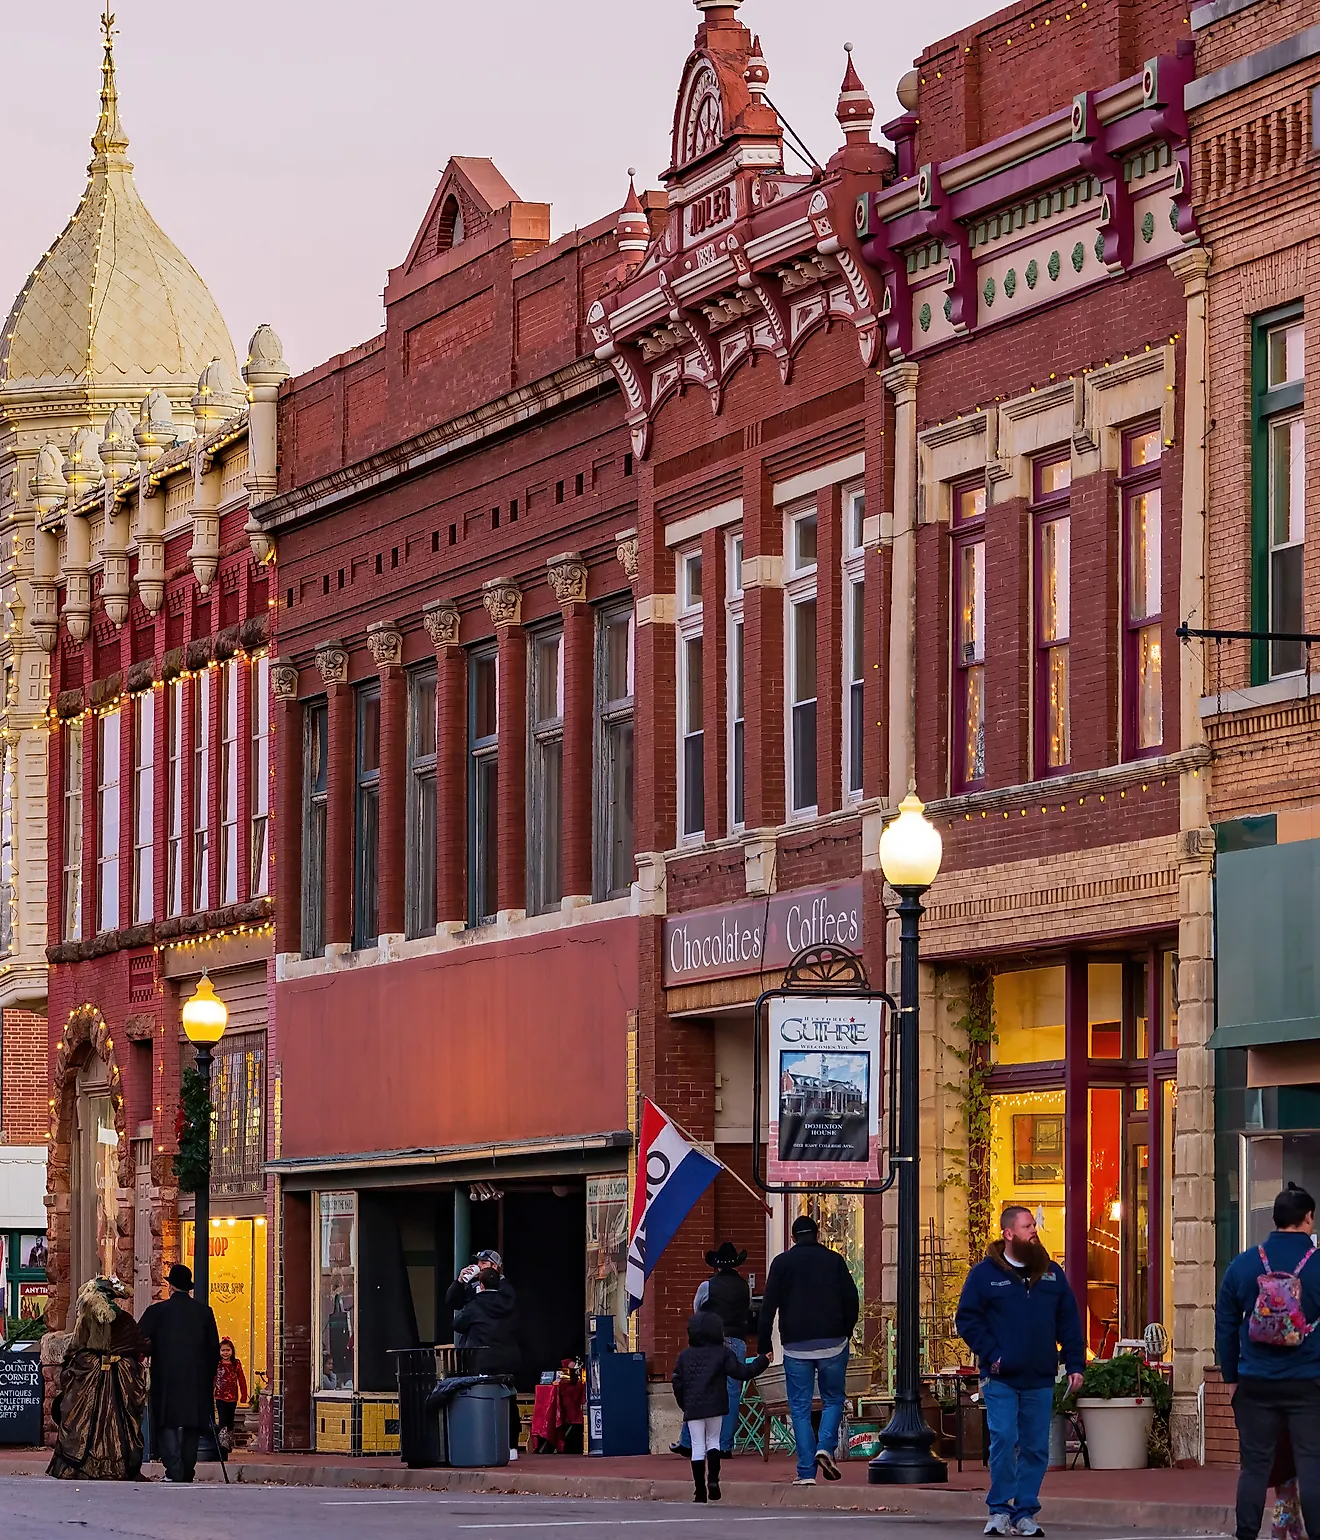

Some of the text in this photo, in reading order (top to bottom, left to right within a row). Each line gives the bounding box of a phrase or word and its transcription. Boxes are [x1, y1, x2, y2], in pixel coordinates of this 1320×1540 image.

[690, 186, 731, 237] ADLER
[670, 894, 859, 973] Chocolates Coffees
[780, 1017, 869, 1045] GUTHRIE
